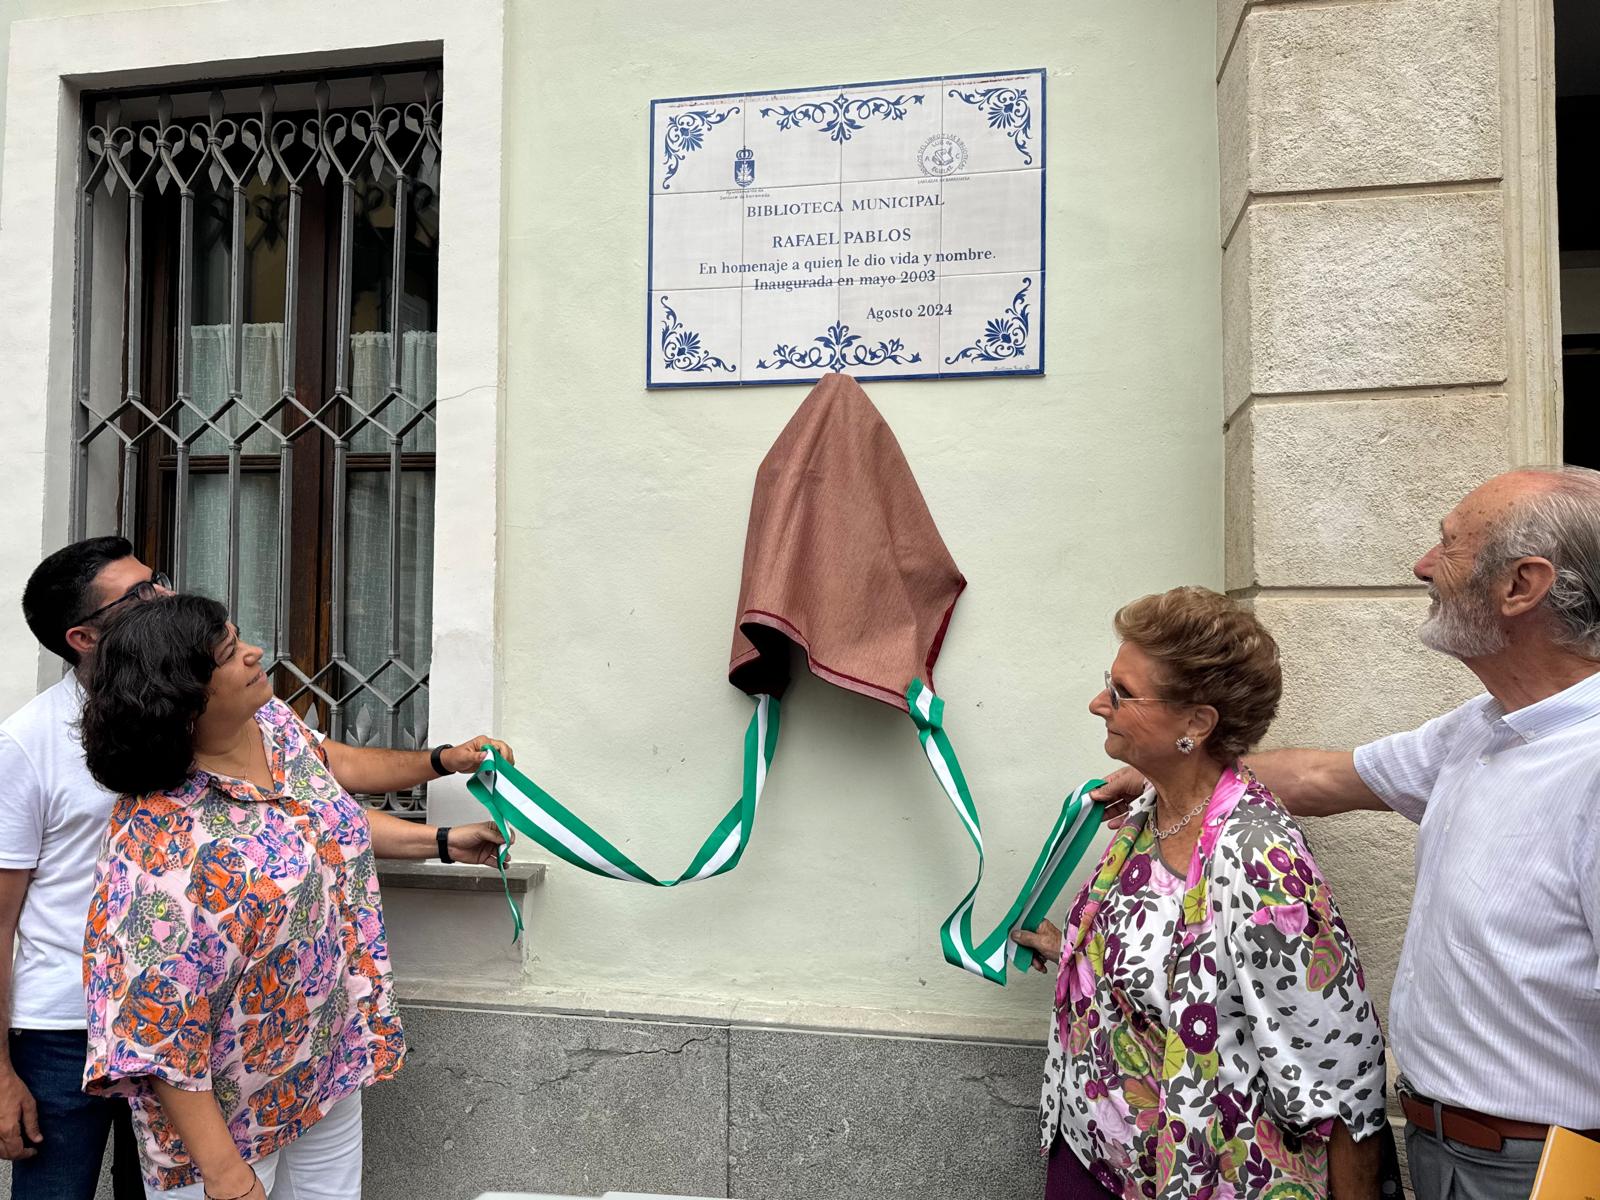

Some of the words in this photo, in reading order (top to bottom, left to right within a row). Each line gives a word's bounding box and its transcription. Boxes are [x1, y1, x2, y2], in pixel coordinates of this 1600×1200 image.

[747, 201, 844, 217] BIBLIOTECA
[852, 194, 945, 211] MUNICIPAL
[772, 232, 839, 248] RAFAEL
[844, 228, 912, 244] PABLOS
[699, 262, 717, 274] En
[721, 259, 788, 274] homenaje
[792, 261, 800, 270] a
[804, 257, 843, 273] quien
[848, 255, 860, 267] le
[864, 253, 886, 266] dio
[890, 251, 919, 265] vida
[923, 253, 932, 266] y
[936, 248, 996, 262] nombre.
[754, 275, 833, 292] Inaugurada
[837, 277, 854, 287] en
[859, 274, 896, 287] mayo
[900, 270, 936, 283] 2003
[867, 307, 913, 322] Agosto
[917, 303, 953, 317] 2024
